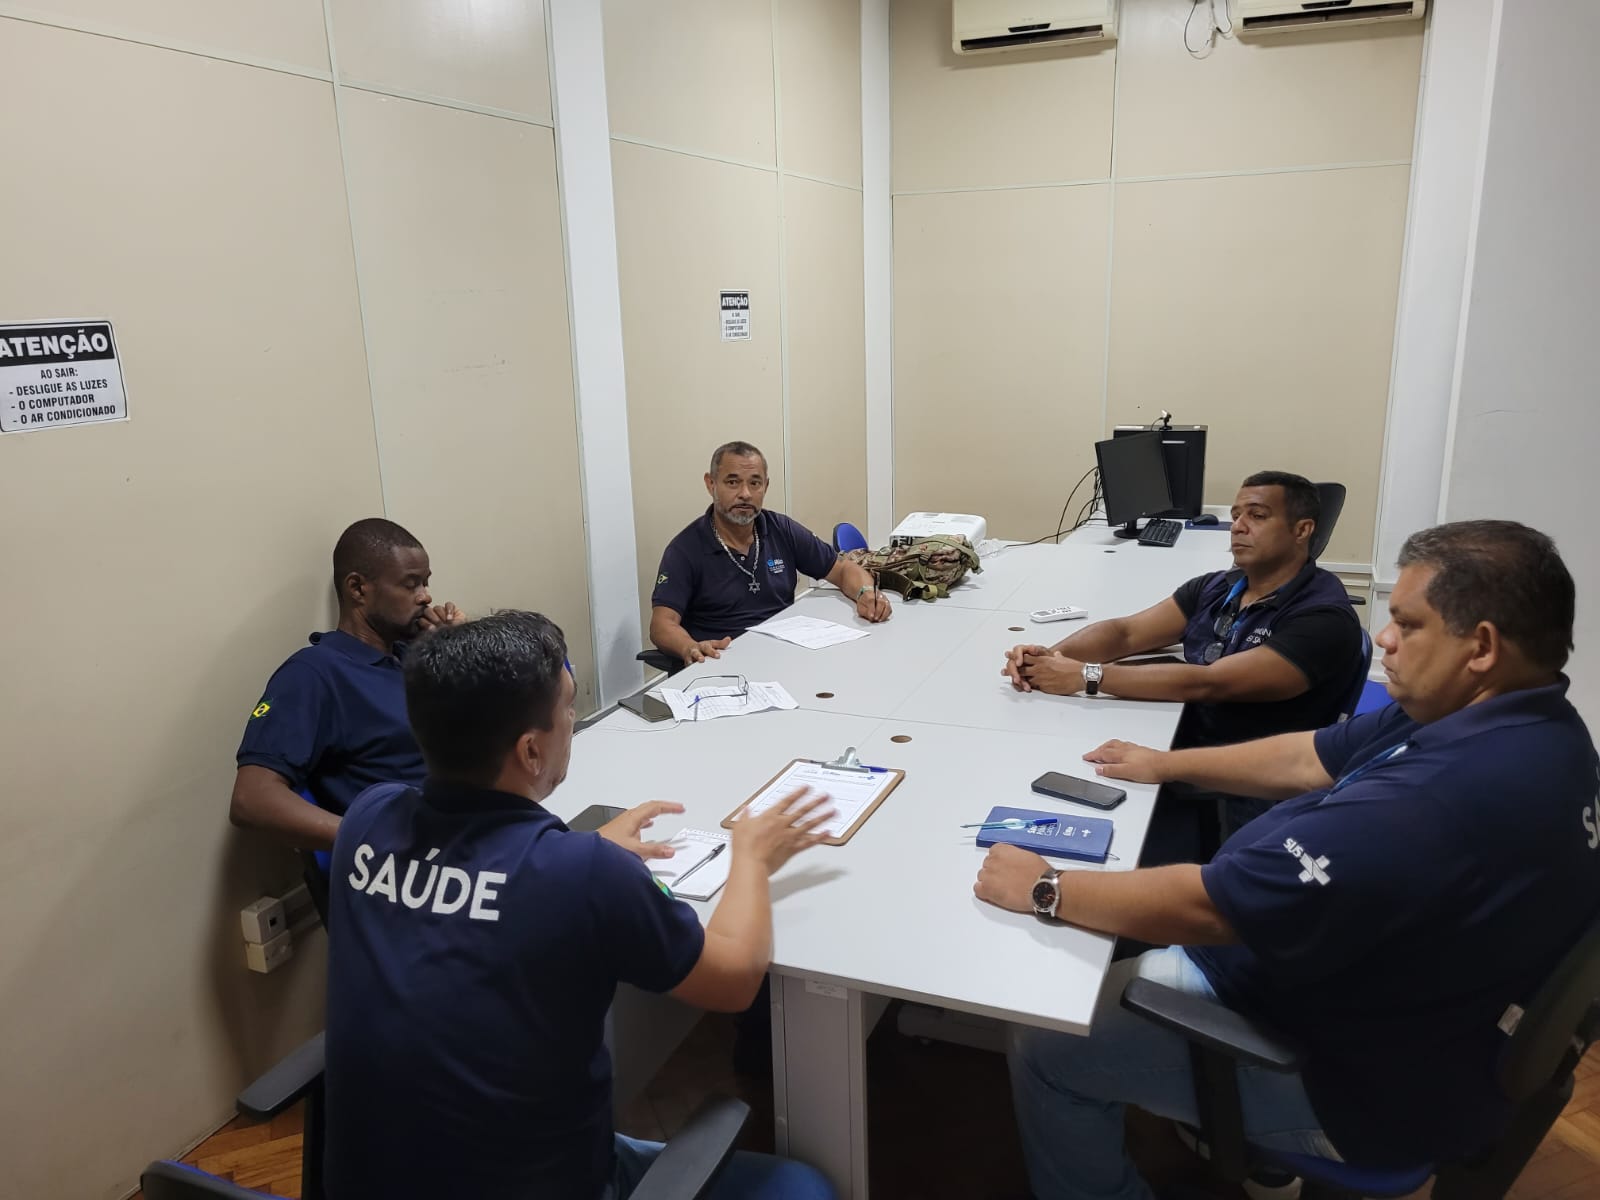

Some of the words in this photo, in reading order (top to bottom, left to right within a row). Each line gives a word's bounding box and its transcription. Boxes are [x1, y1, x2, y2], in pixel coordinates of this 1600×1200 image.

[0, 329, 108, 359] ATENÇÃO
[40, 368, 52, 379] AO
[55, 367, 78, 378] SAIR:
[16, 382, 63, 396] DESLIGUE
[66, 381, 78, 392] AS
[80, 378, 108, 390] LUZES
[19, 400, 25, 411] O
[29, 394, 95, 409] COMPUTADOR
[20, 414, 27, 424] O
[31, 412, 44, 423] AR
[47, 405, 116, 421] CONDICIONADO
[1282, 838, 1304, 858] SUS
[348, 844, 507, 921] SAÚDE
